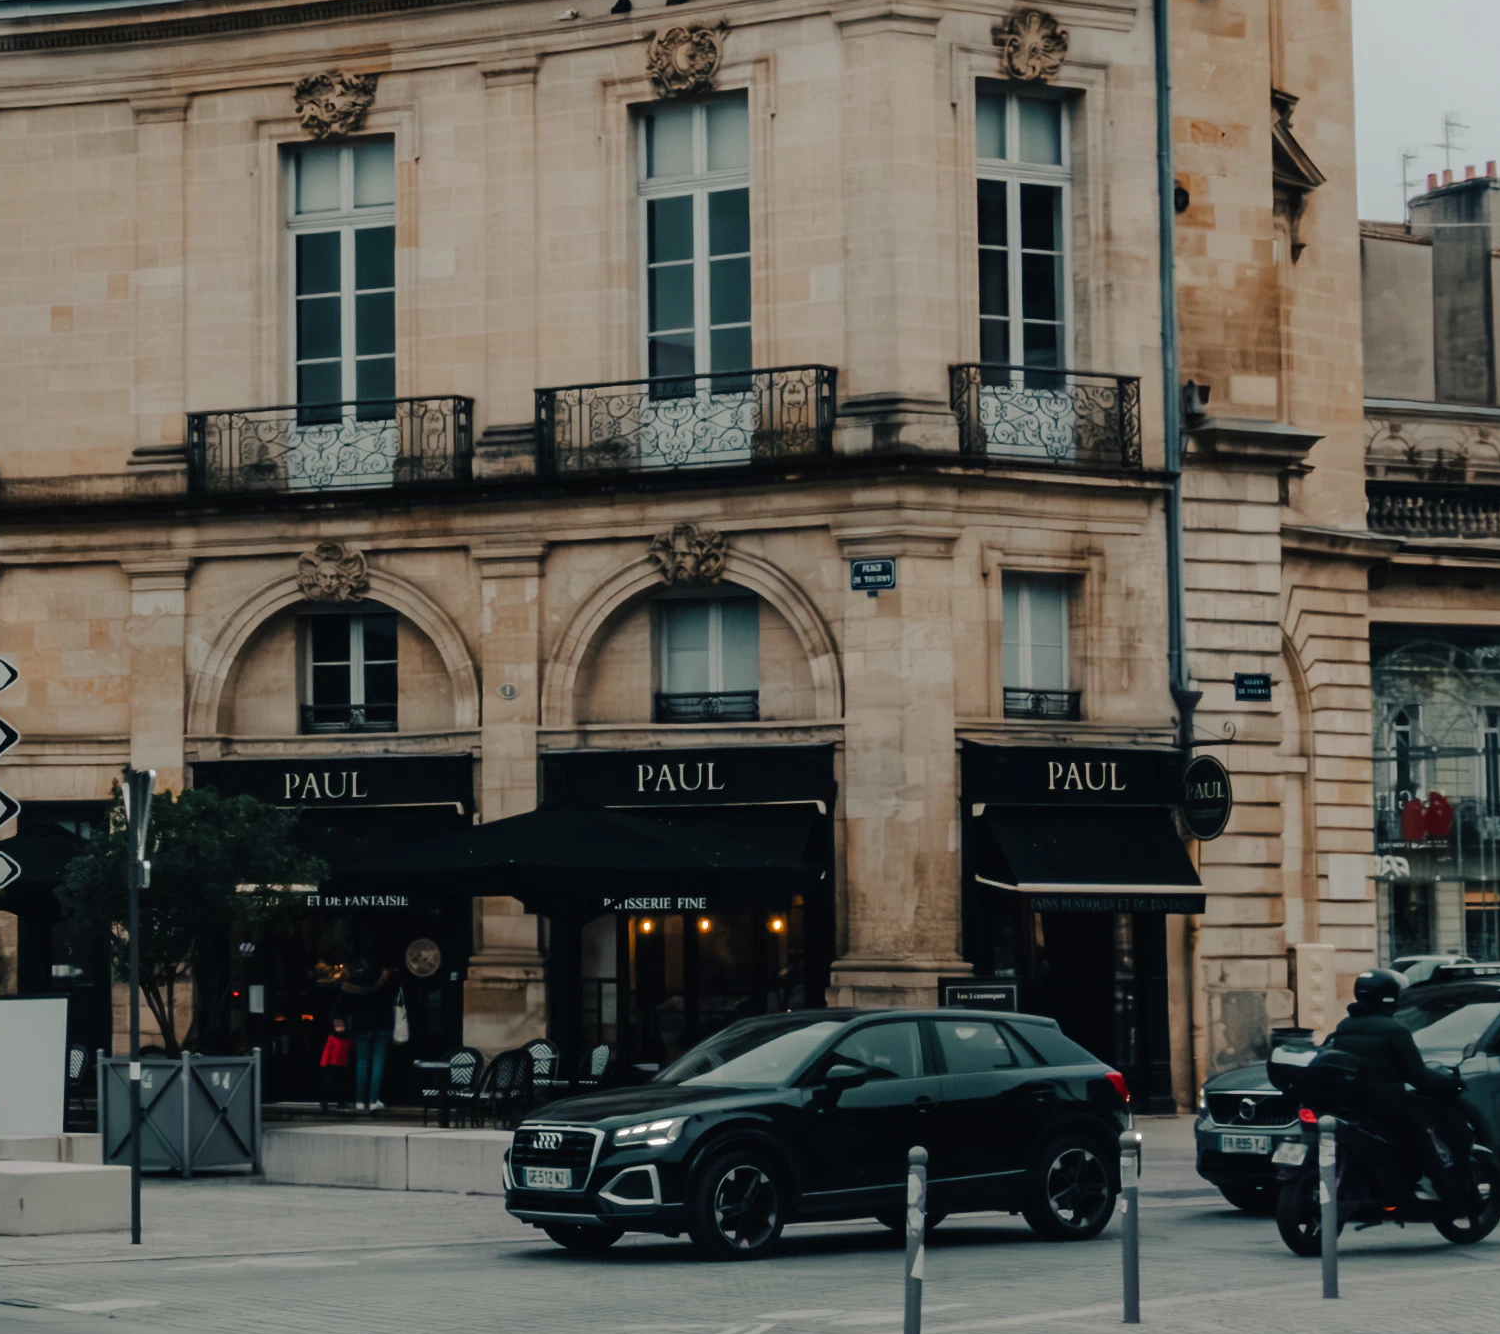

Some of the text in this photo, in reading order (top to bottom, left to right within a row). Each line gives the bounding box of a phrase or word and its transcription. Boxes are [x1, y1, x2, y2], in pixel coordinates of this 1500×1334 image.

[283, 771, 368, 799] PAUL
[636, 762, 726, 792] PAUL
[1047, 761, 1128, 791] PAUL
[1185, 781, 1226, 799] PAUL
[306, 895, 409, 907] ET DE FANTAISIE
[677, 897, 707, 909] FINE
